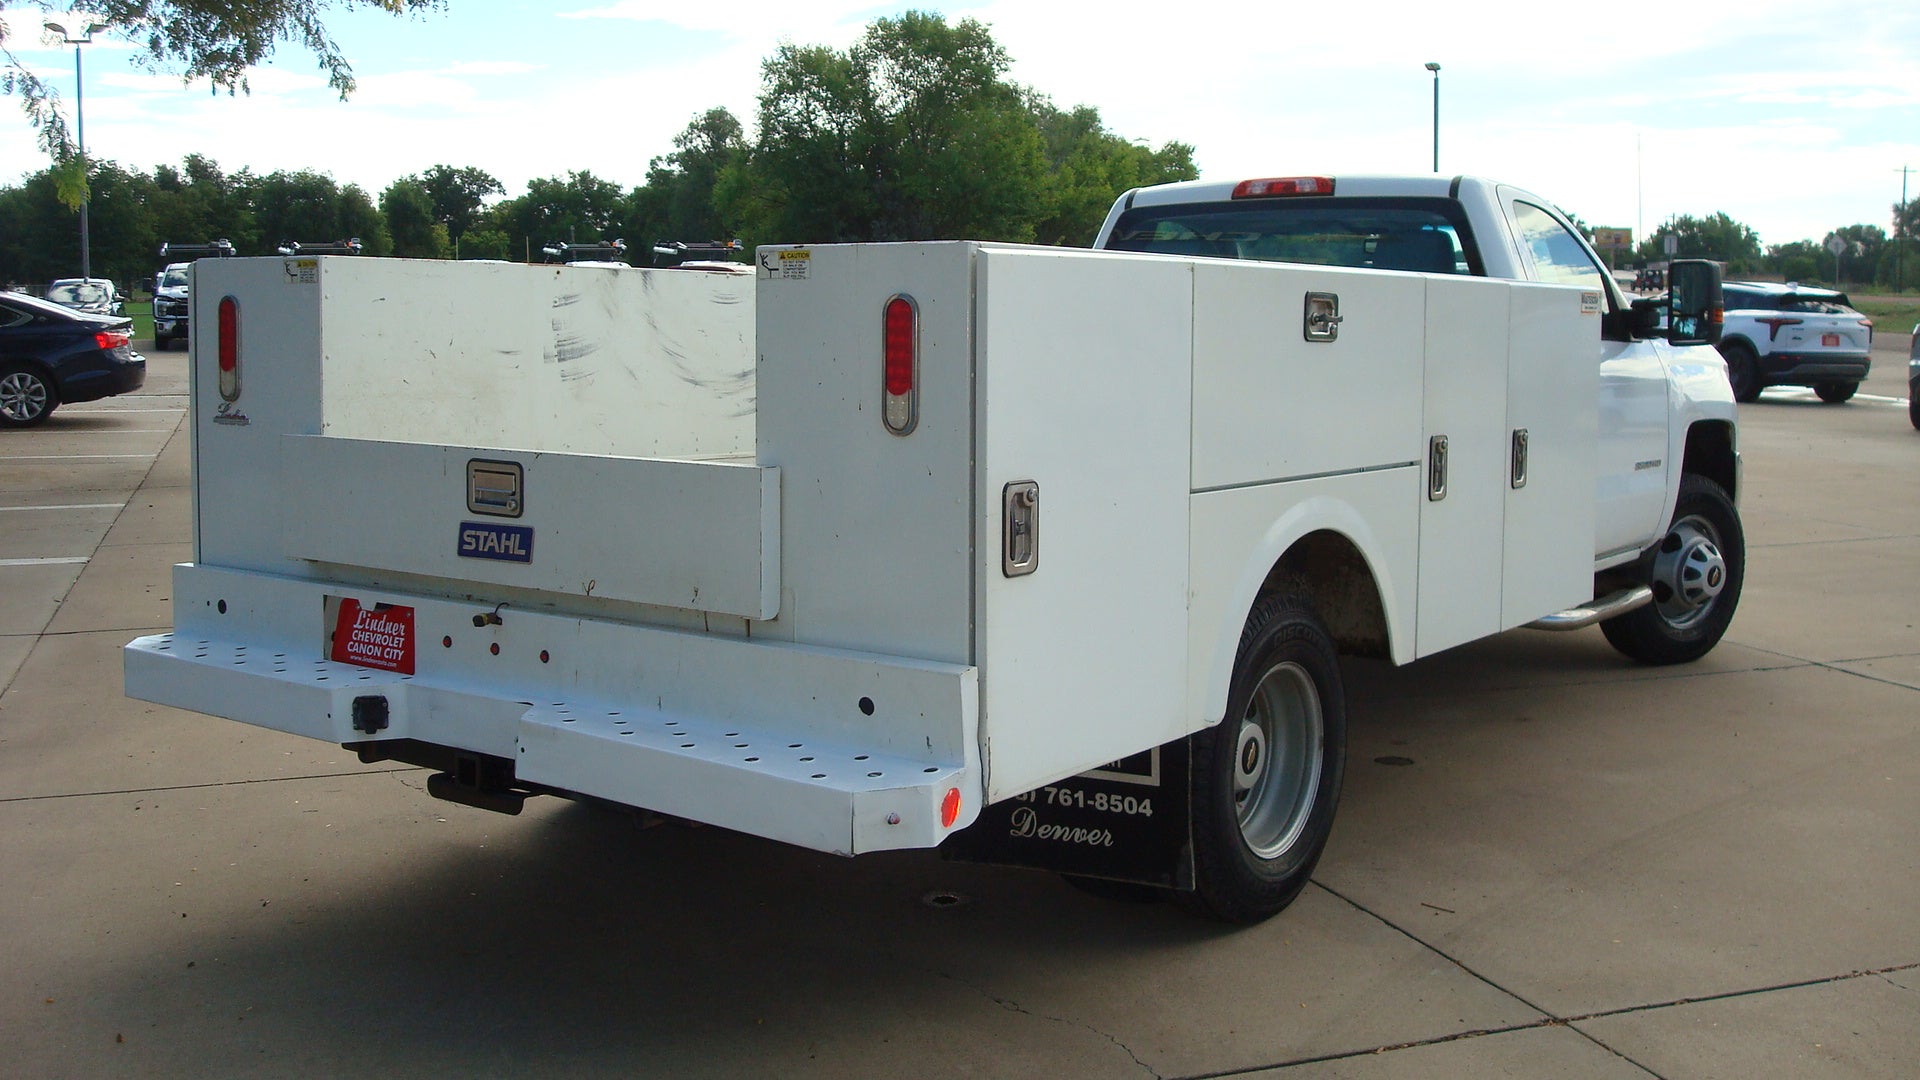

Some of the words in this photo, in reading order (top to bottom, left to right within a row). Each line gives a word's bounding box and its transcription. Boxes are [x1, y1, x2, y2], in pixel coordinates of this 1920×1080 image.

[462, 529, 527, 556] STAHL
[353, 610, 406, 636] Lindner
[347, 641, 382, 657] CANON
[383, 647, 404, 661] CITY
[351, 630, 405, 648] CHEVROLET
[1044, 786, 1153, 817] 761-8504
[1010, 806, 1114, 847] Denver
